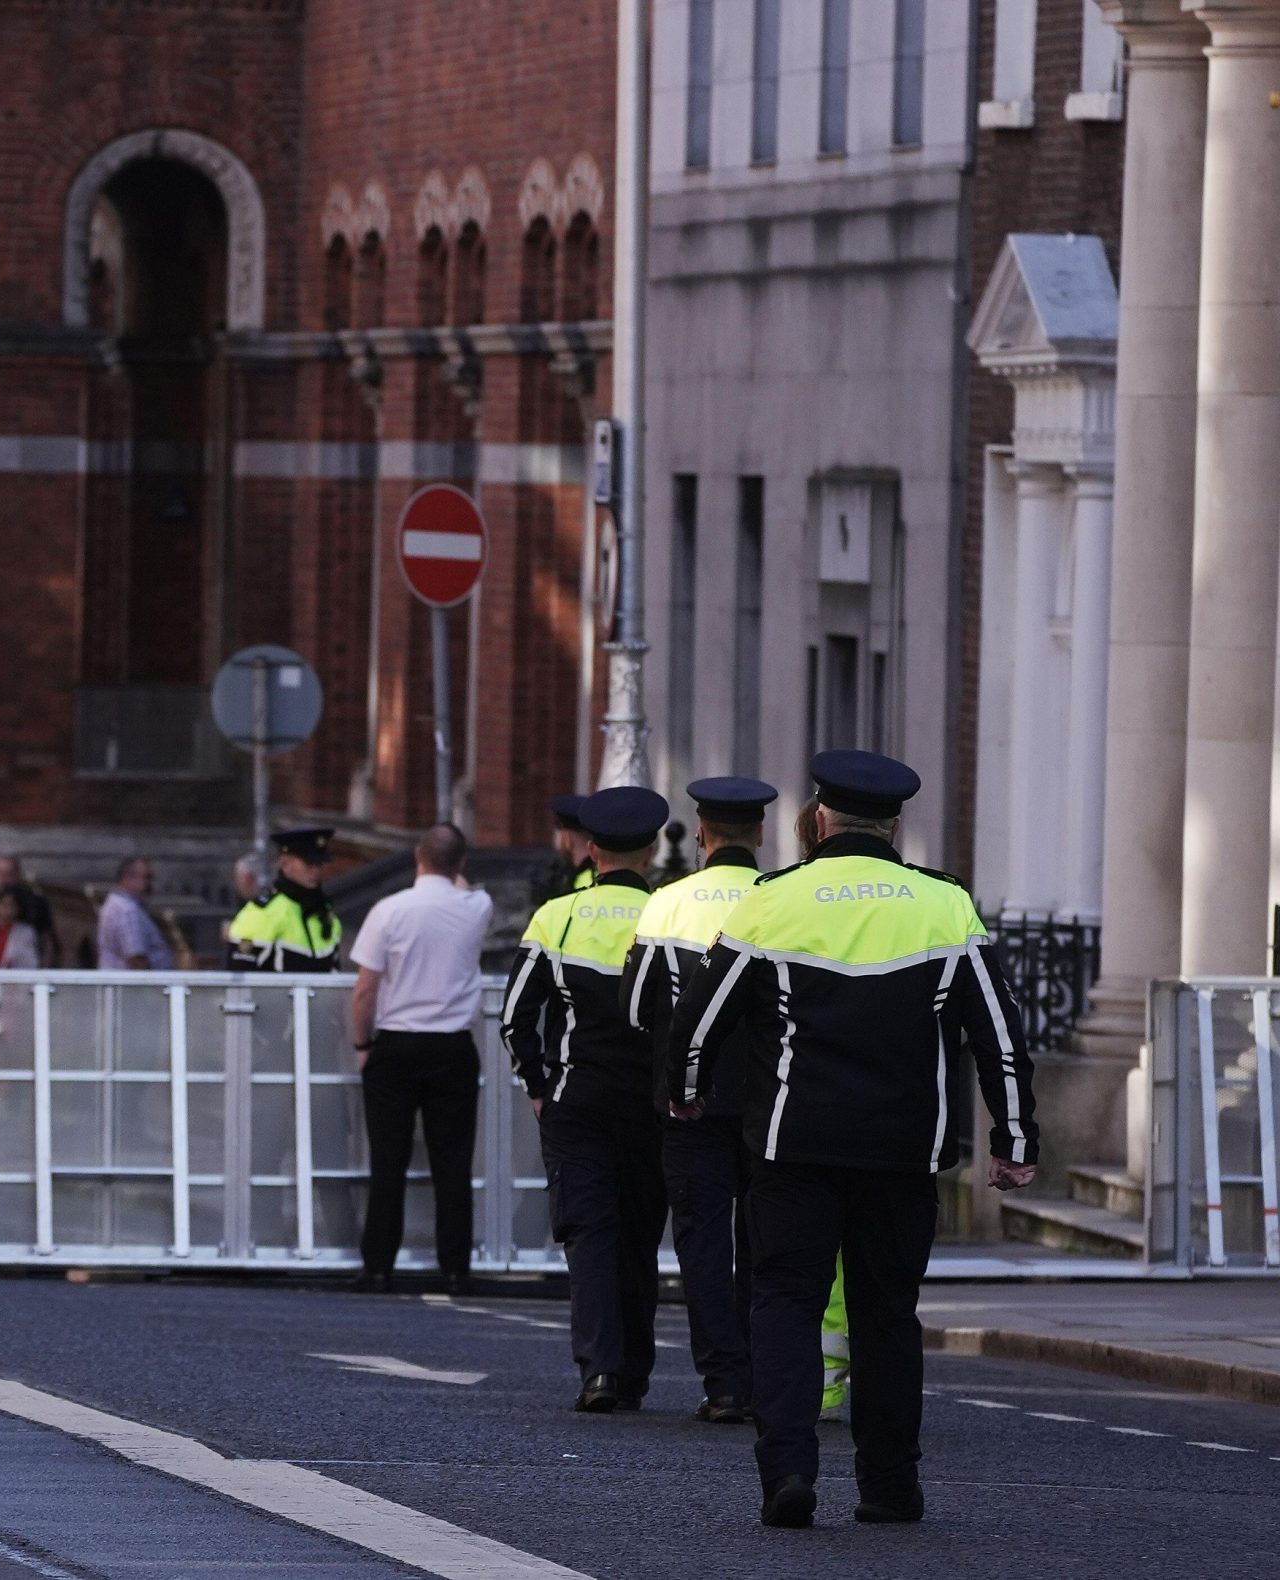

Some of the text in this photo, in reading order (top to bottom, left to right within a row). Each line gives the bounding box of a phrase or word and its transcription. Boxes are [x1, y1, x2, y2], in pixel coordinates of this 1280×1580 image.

[693, 888, 746, 902] GAR
[815, 883, 915, 903] GARDA
[578, 904, 641, 920] GARD
